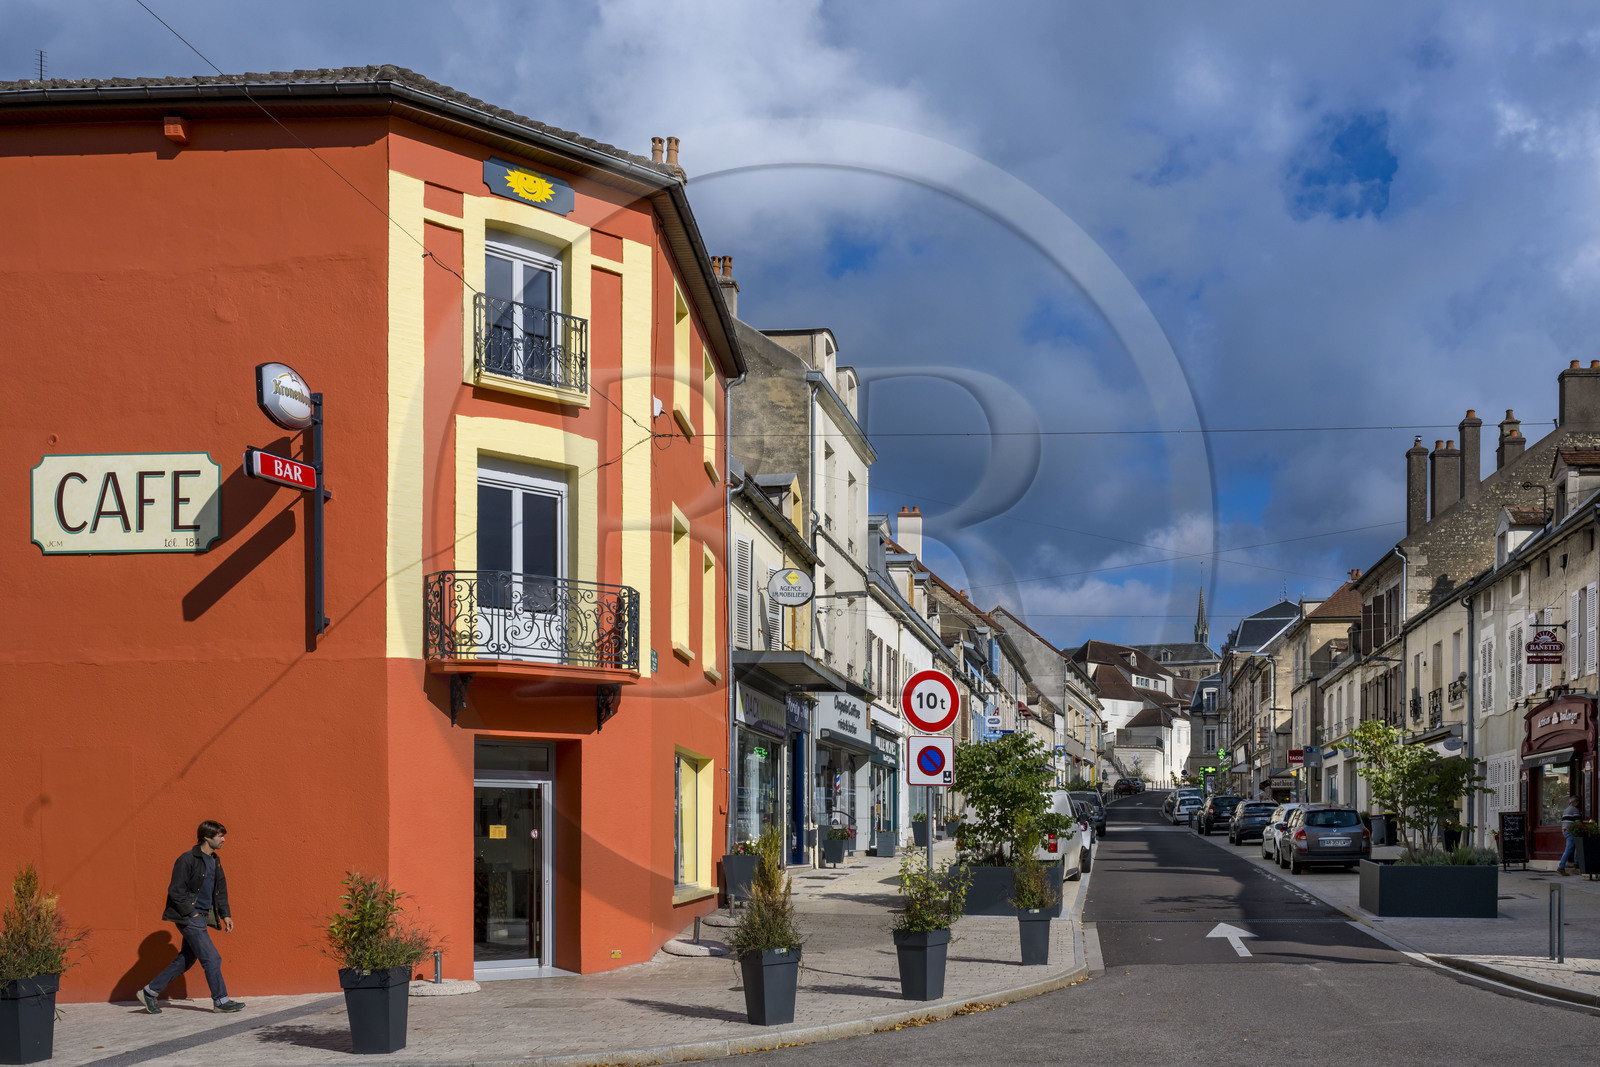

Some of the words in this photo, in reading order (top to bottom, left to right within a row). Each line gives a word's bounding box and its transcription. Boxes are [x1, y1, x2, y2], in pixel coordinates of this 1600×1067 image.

[274, 459, 303, 483] BAR
[54, 470, 201, 534] CAFE
[185, 537, 200, 547] 184
